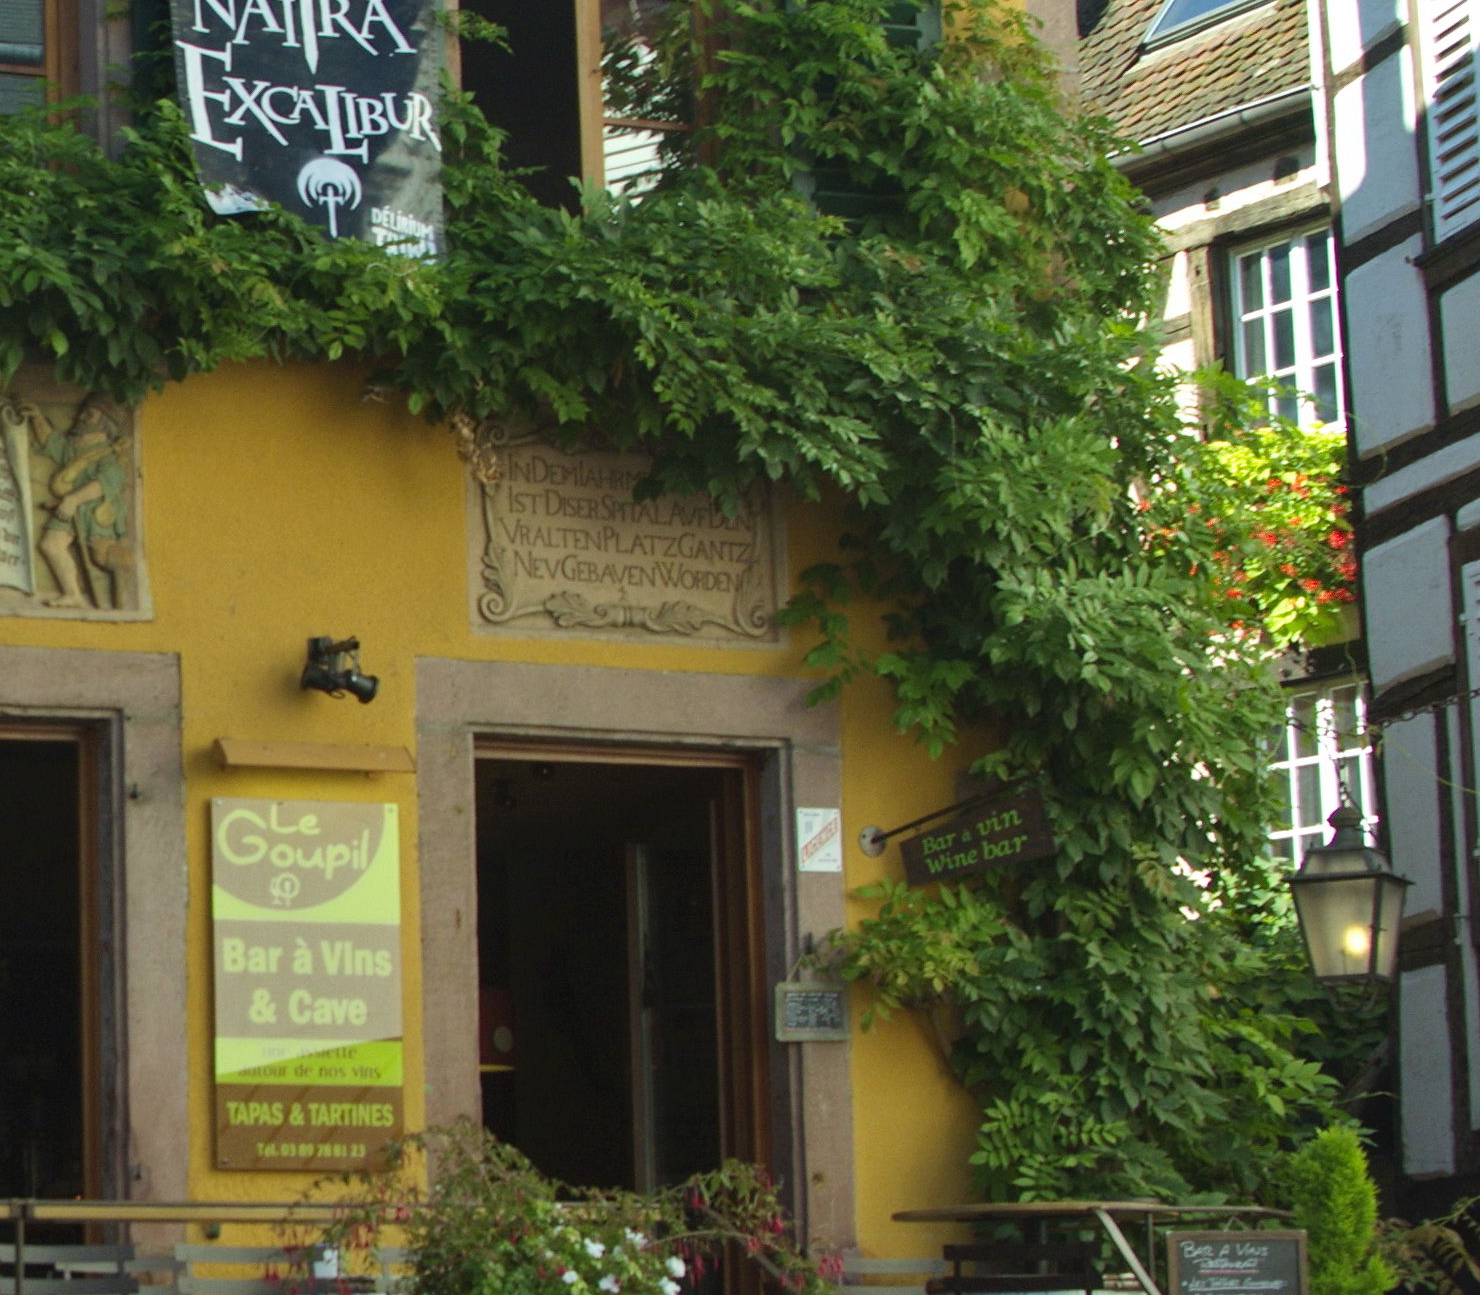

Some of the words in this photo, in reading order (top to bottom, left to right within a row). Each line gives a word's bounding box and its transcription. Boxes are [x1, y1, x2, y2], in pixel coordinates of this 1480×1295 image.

[270, 804, 321, 836] Le
[922, 833, 957, 855] Bar
[976, 809, 1023, 836] vin
[218, 807, 370, 881] Goupil
[925, 848, 979, 874] Wine
[981, 834, 1029, 861] bar
[222, 937, 283, 975] Bar
[293, 936, 315, 975] à
[321, 940, 394, 978] Vins
[248, 987, 277, 1025] &
[287, 988, 368, 1026] Cave
[294, 1064, 312, 1077] de
[319, 1066, 347, 1078] nos
[352, 1064, 381, 1080] vins
[226, 1101, 284, 1126] TAPAS
[289, 1102, 305, 1126] &
[307, 1102, 395, 1127] TARTINES
